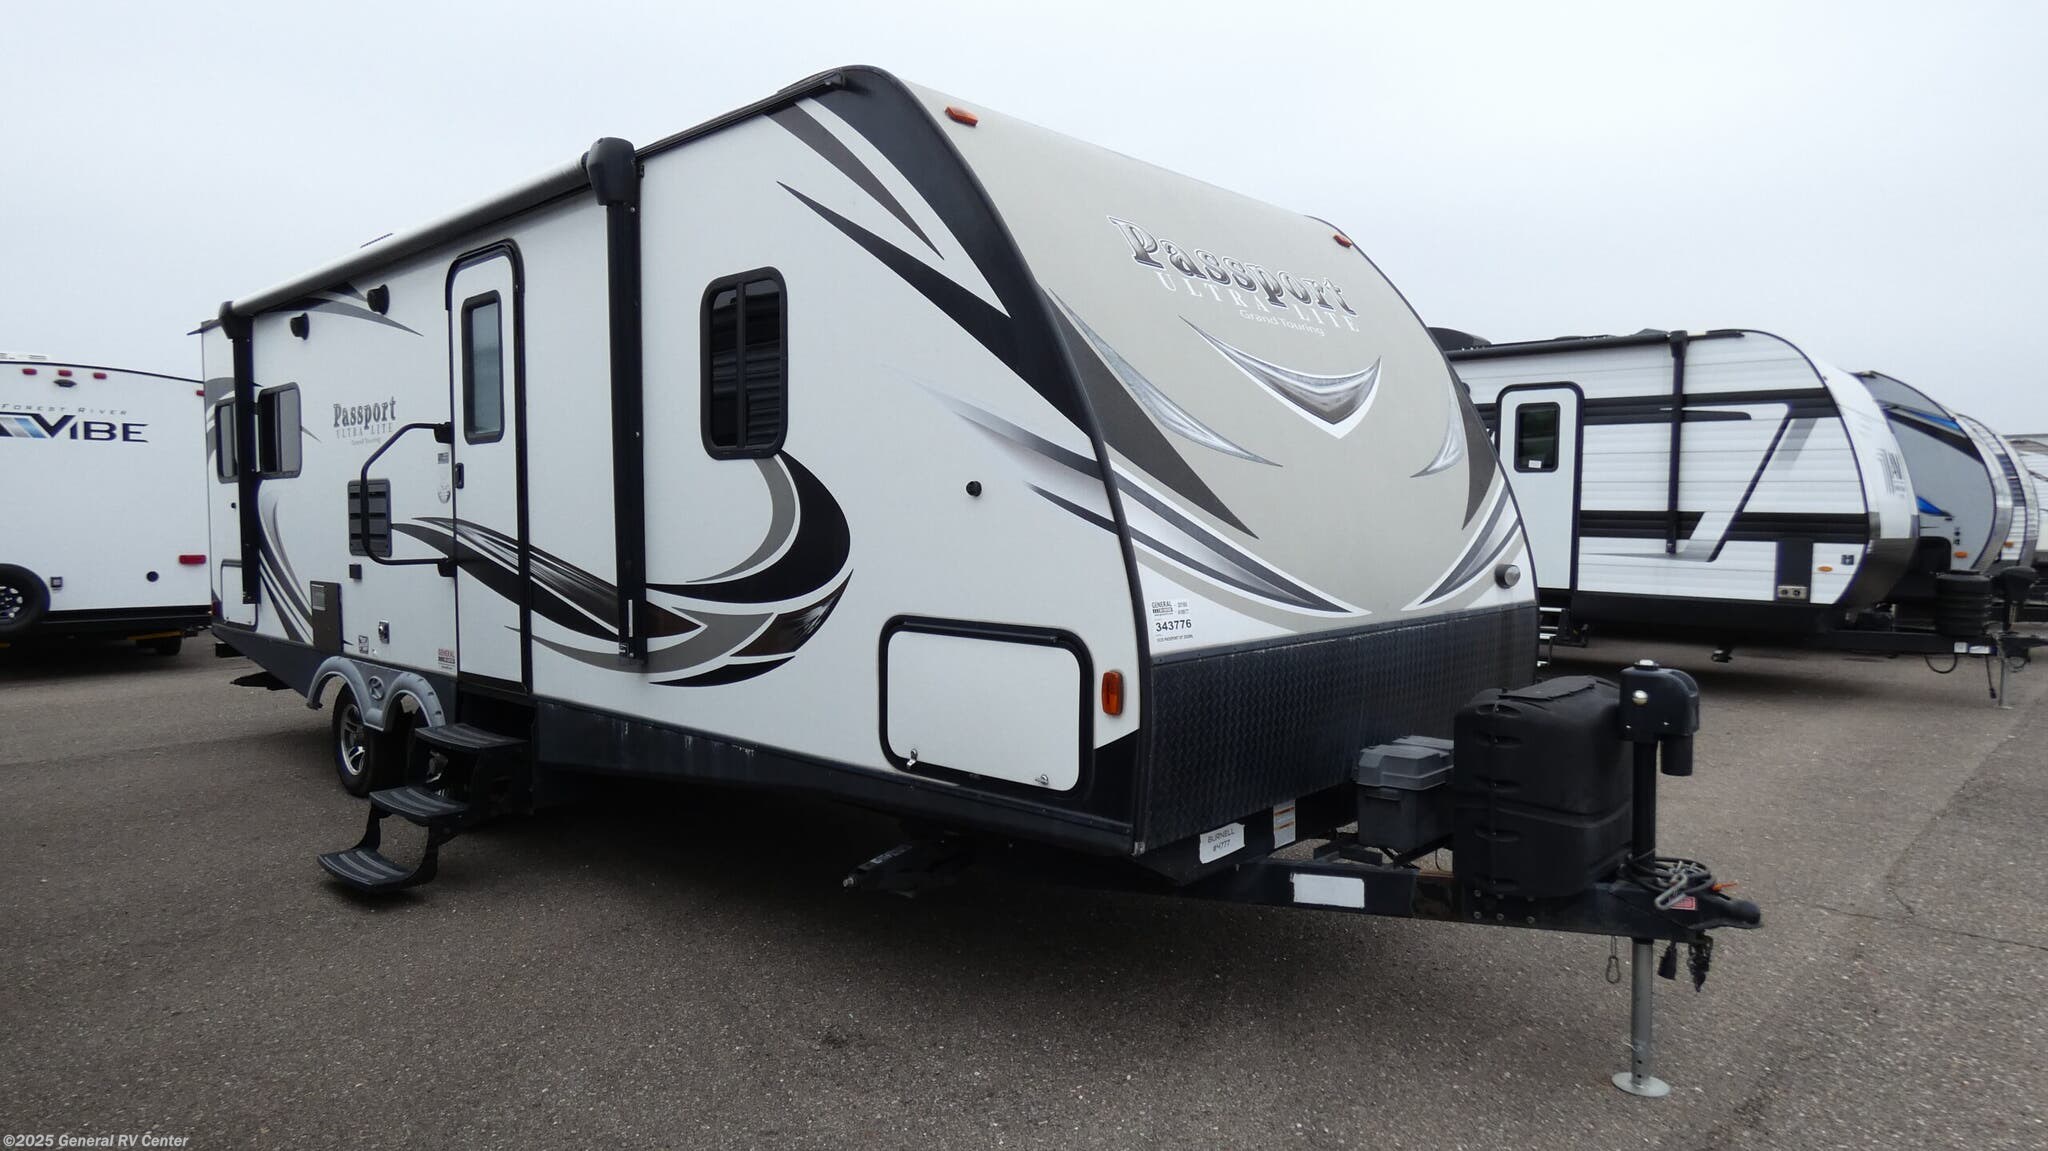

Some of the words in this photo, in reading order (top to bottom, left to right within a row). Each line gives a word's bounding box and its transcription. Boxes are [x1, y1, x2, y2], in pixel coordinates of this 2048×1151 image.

[1106, 216, 1359, 316] Passport
[1155, 271, 1270, 313] ULTRA
[1292, 302, 1360, 332] LITE
[1239, 309, 1280, 325] Grand
[29, 412, 149, 443] VIBE
[333, 396, 396, 430] Passport
[1155, 618, 1192, 632] 343776
